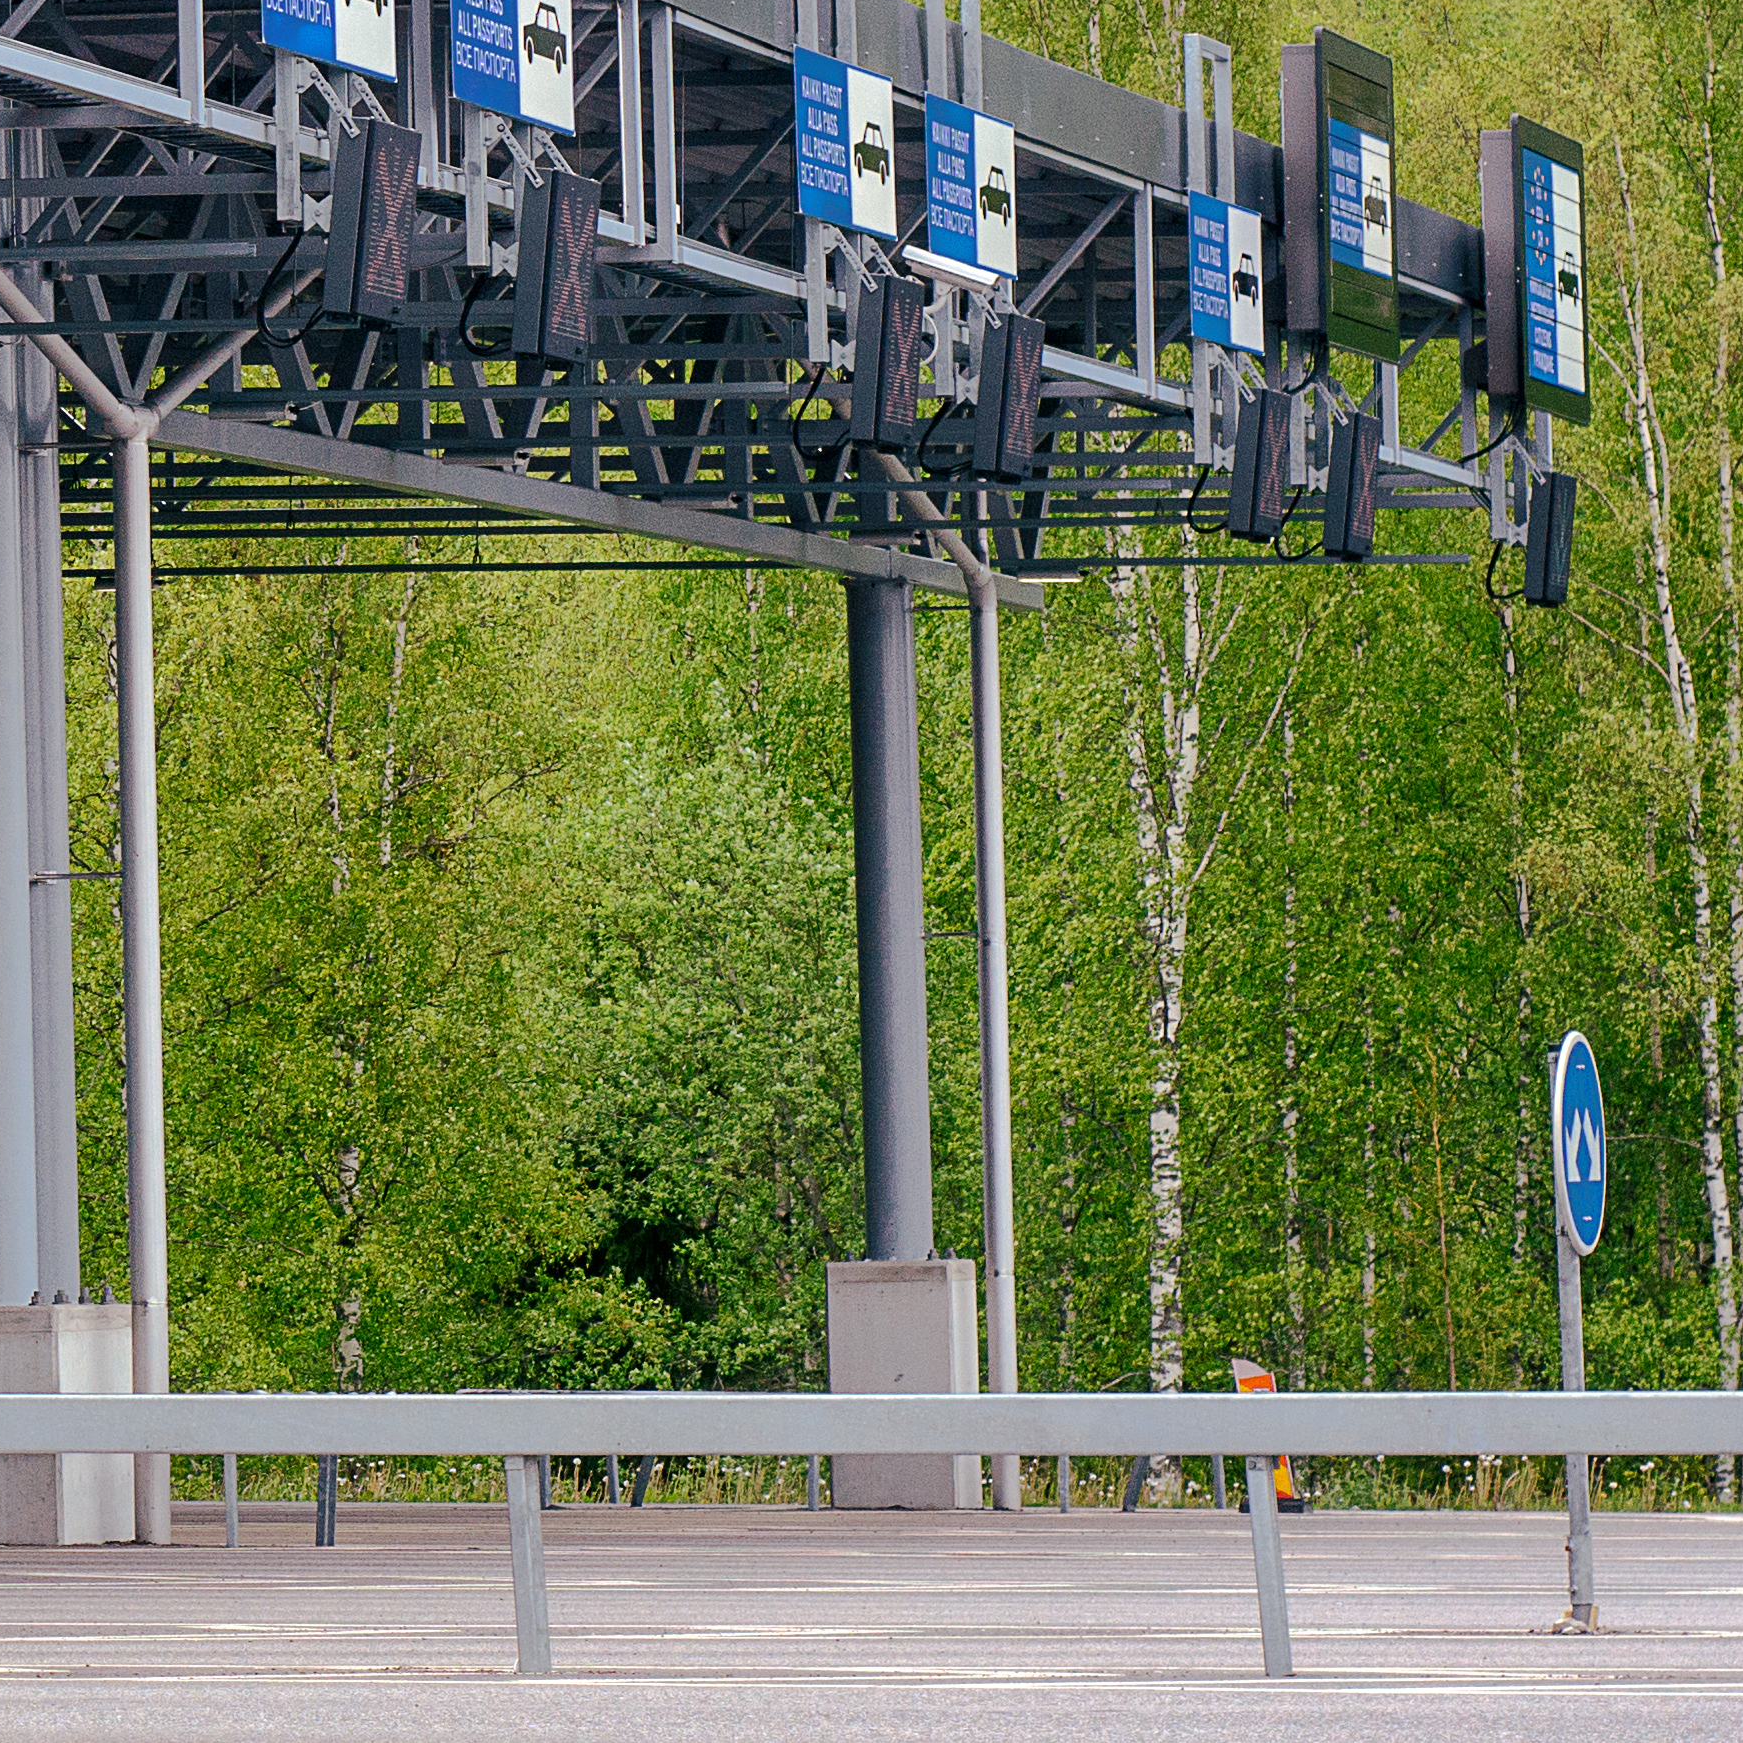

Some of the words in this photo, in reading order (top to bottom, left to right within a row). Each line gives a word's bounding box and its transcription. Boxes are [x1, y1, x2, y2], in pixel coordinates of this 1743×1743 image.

[458, 10, 471, 36] ALL
[473, 14, 512, 50] PASSPORTS
[456, 41, 472, 69] ВСЕ
[473, 47, 516, 83] ПАСПОРТА
